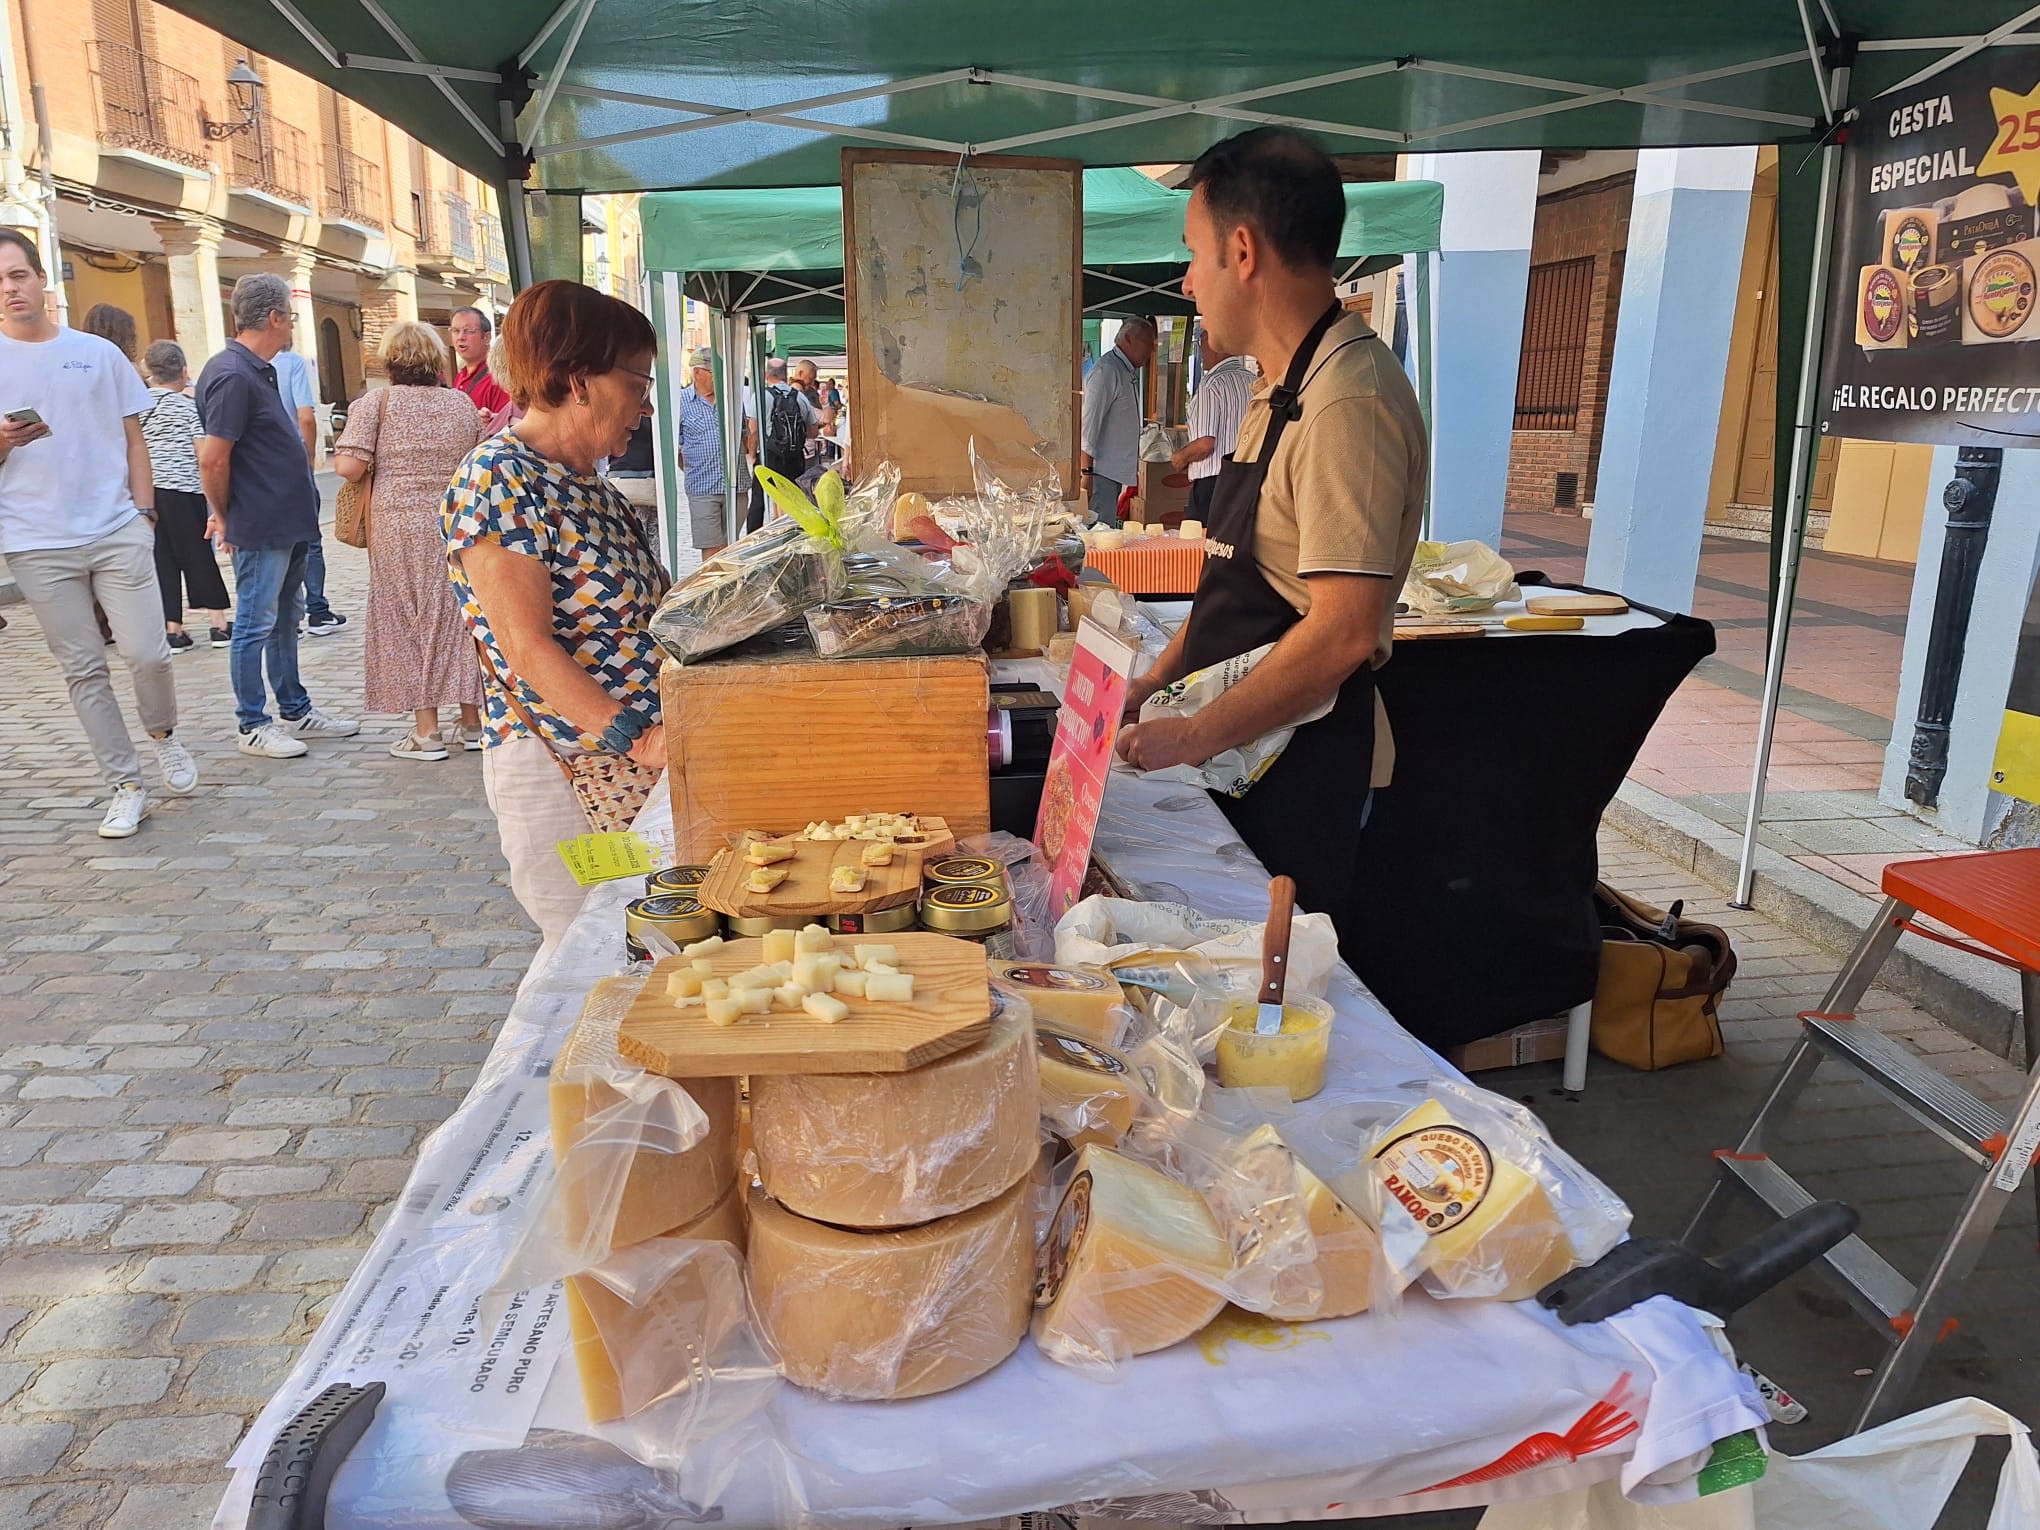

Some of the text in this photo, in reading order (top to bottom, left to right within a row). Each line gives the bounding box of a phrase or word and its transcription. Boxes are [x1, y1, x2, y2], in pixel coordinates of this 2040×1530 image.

[1888, 94, 1954, 139] CESTA
[1998, 110, 2040, 155] 25
[1869, 147, 1976, 194] ESPECIAL
[1832, 384, 1857, 412] ¡¡EL
[1859, 386, 1937, 412] REGALO
[515, 1130, 533, 1142] 12
[1421, 1133, 1484, 1187] QUESO DE OVEJA
[456, 1172, 476, 1195] Awards
[1384, 1174, 1430, 1221] RAMOS
[444, 1195, 461, 1212] 2022
[384, 1286, 408, 1312] Queso
[428, 1285, 450, 1311] Medio
[452, 1327, 475, 1346] 10
[470, 1289, 529, 1393] EJA SEMICURADO
[505, 1293, 560, 1394] ARTESANO PURO
[398, 1341, 424, 1361] 20
[303, 1362, 328, 1391] Castilla
